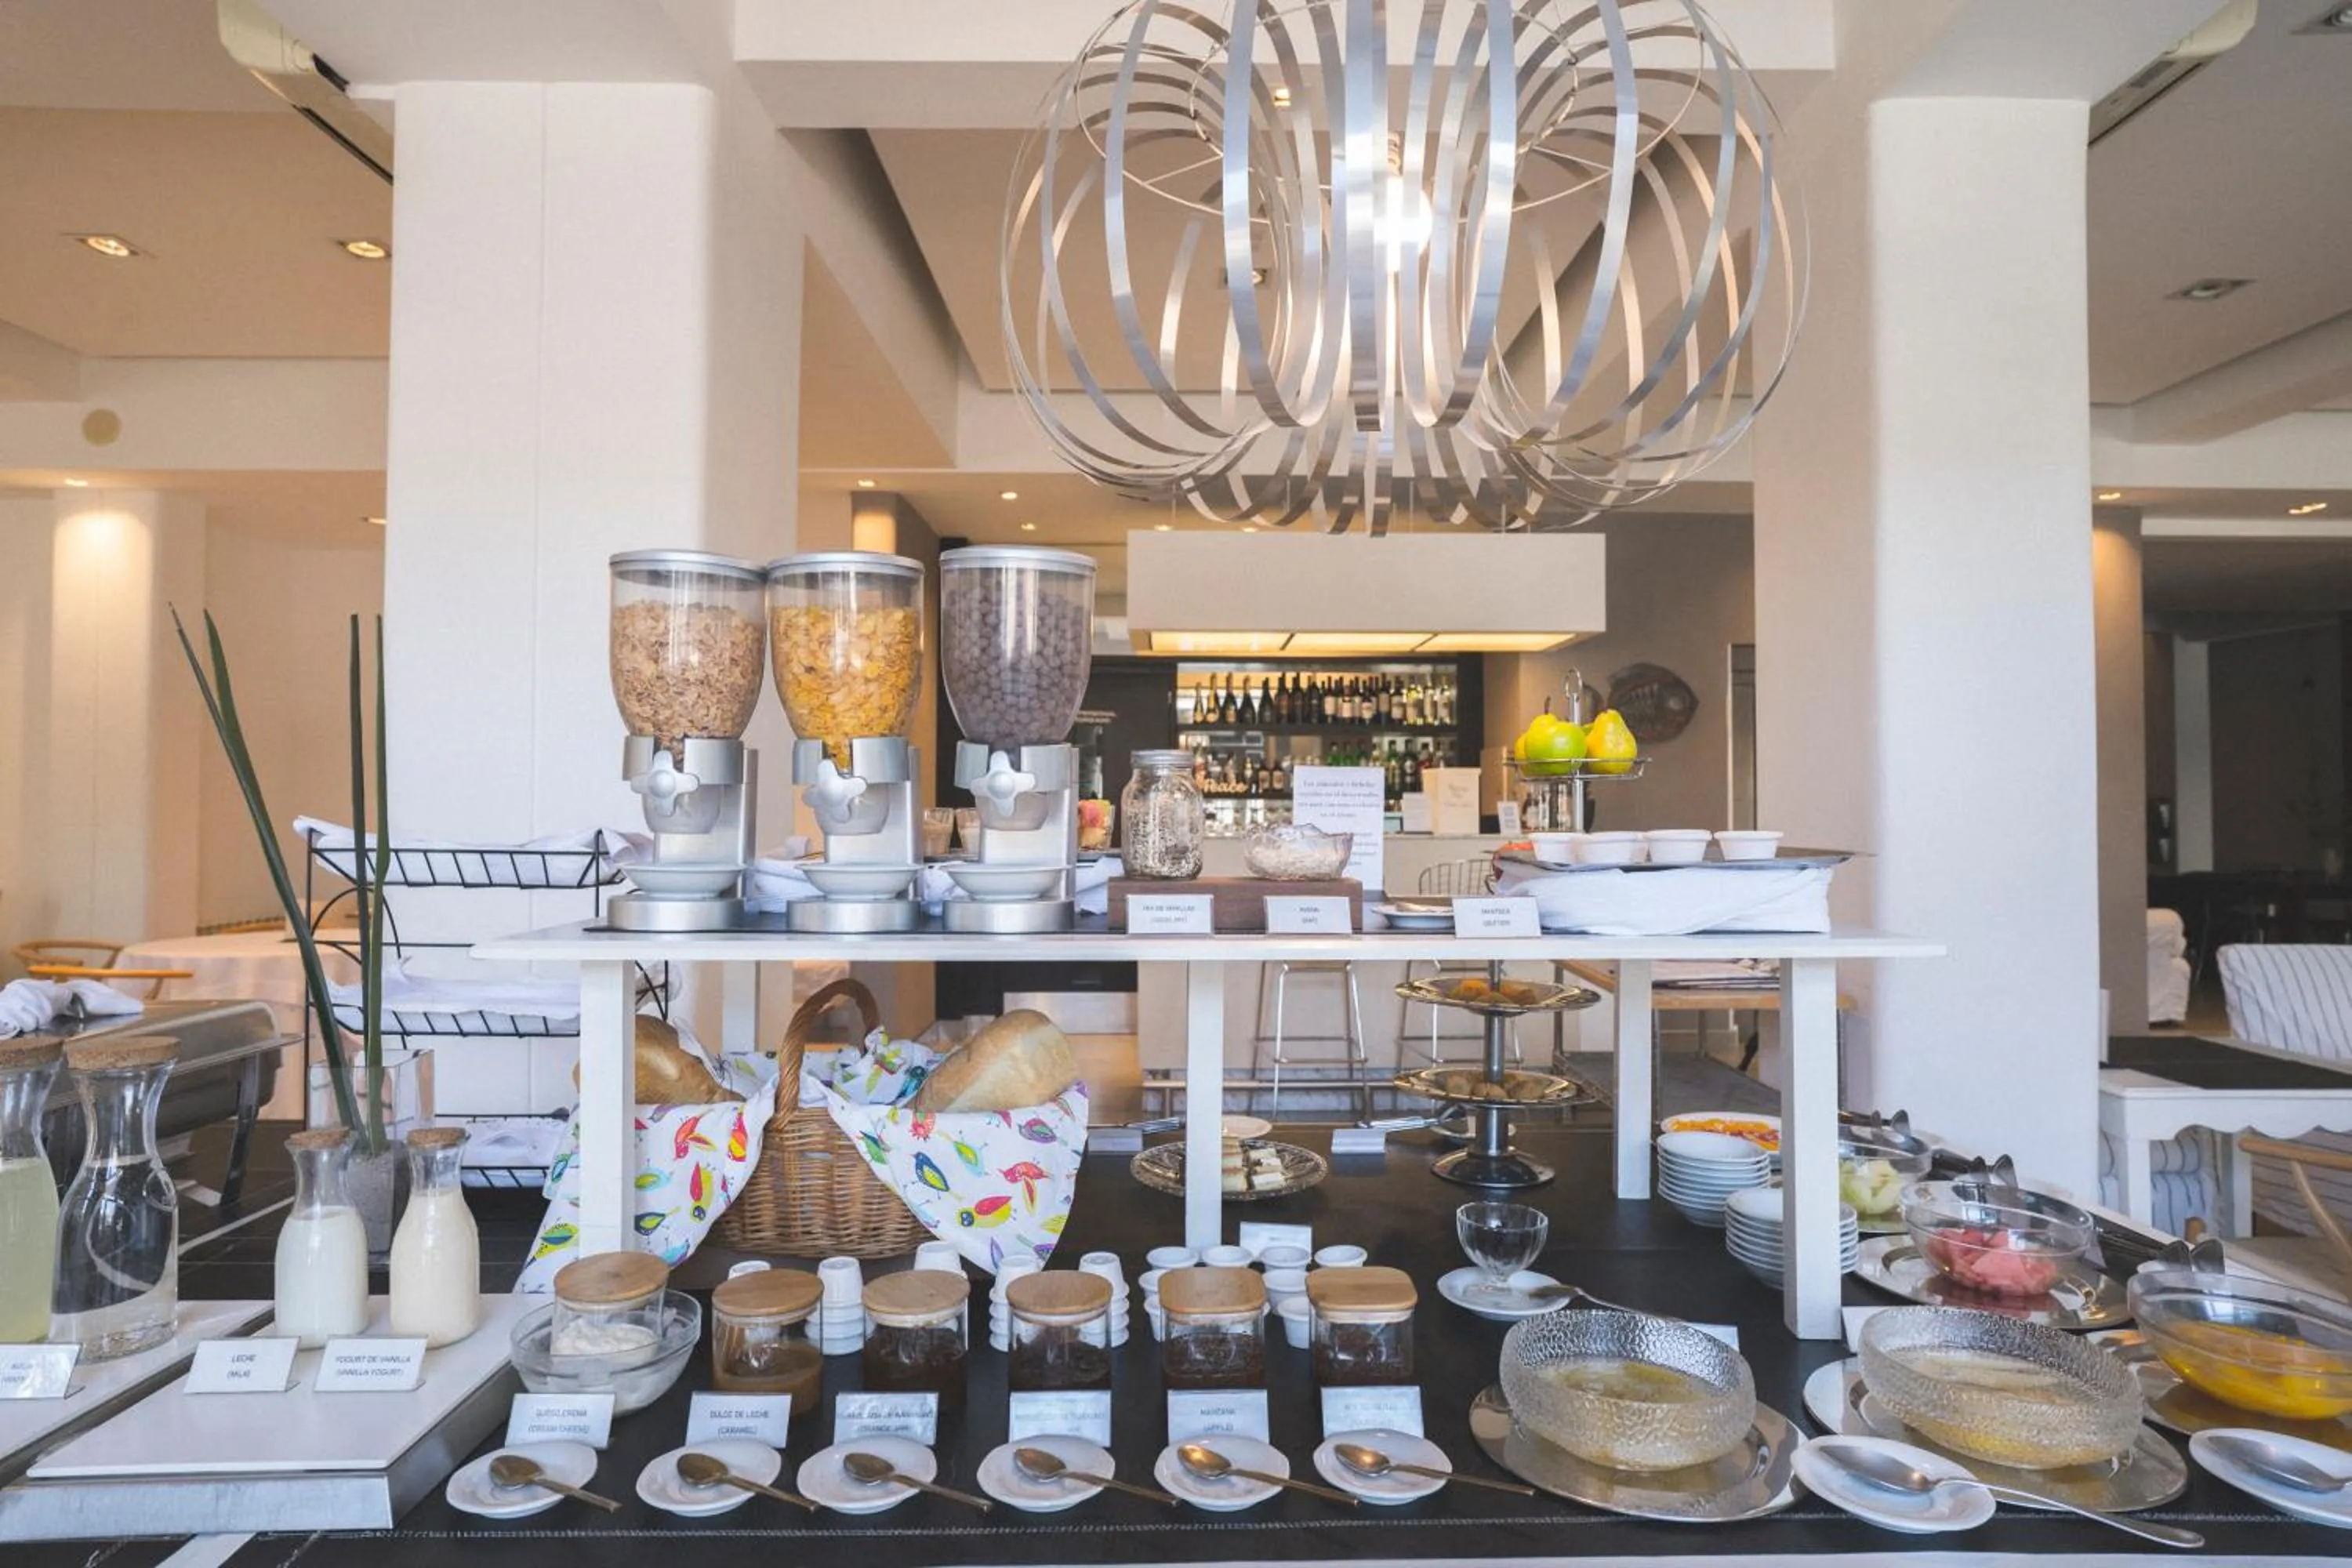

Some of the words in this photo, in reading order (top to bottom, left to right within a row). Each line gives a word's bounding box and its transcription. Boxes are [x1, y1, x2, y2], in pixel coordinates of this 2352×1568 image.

[231, 1354, 256, 1363] LECHE
[710, 1410, 732, 1418] DULCE
[735, 1410, 743, 1418] DE
[746, 1410, 769, 1418] LECHE
